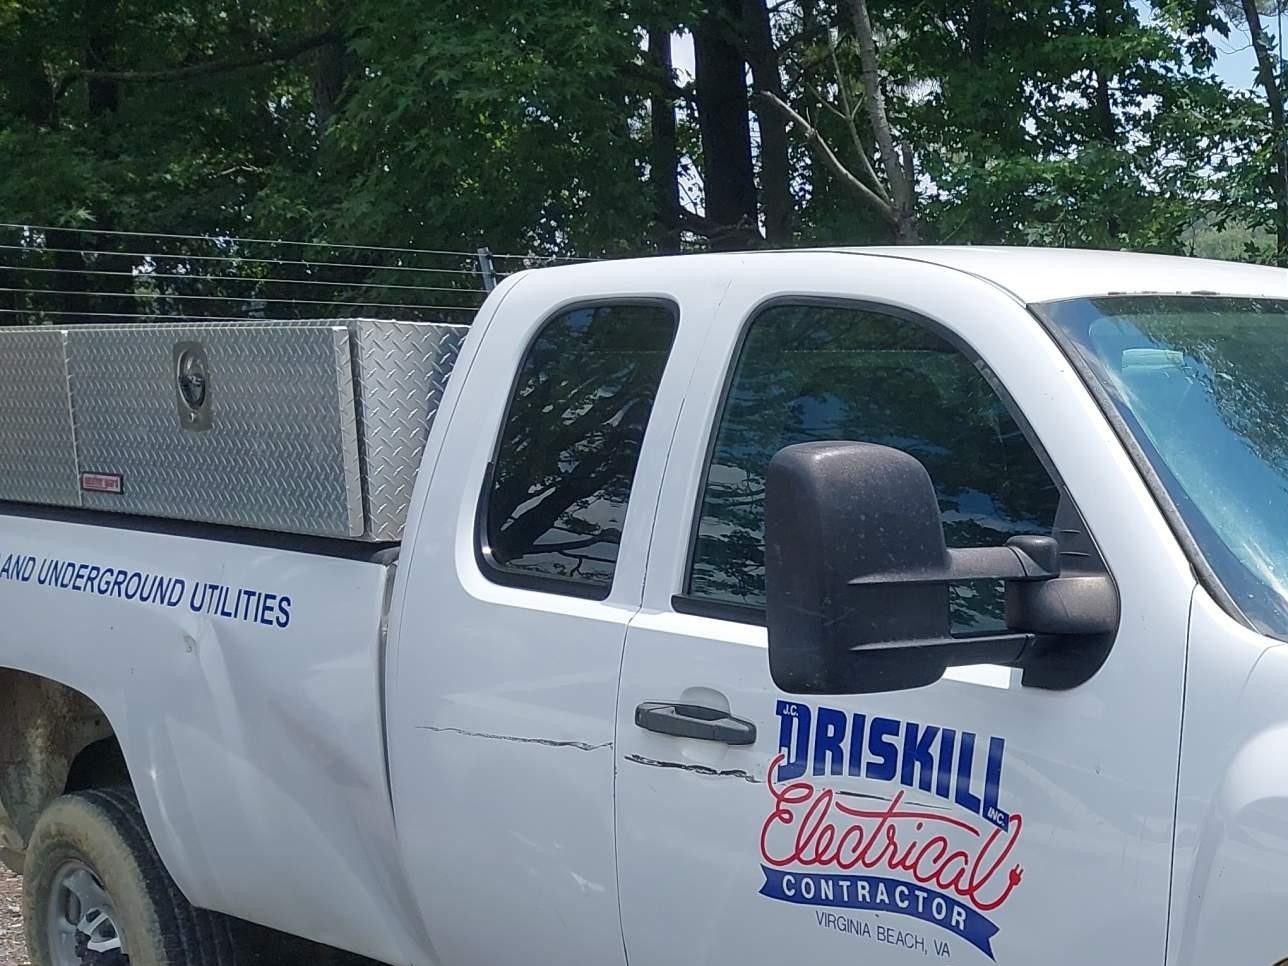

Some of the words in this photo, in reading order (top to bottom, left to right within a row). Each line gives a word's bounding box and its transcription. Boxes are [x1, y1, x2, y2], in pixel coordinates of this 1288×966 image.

[0, 553, 36, 582] AND
[38, 558, 186, 608] UNDERGROUND
[189, 583, 291, 628] UTILITIES
[776, 699, 1009, 832] DRISKILL
[760, 753, 1023, 911] Electrical
[782, 875, 968, 931] CONTRACTOR
[815, 911, 871, 939] VIRGINIA
[876, 926, 928, 956] BEACH,
[934, 939, 951, 958] VA
